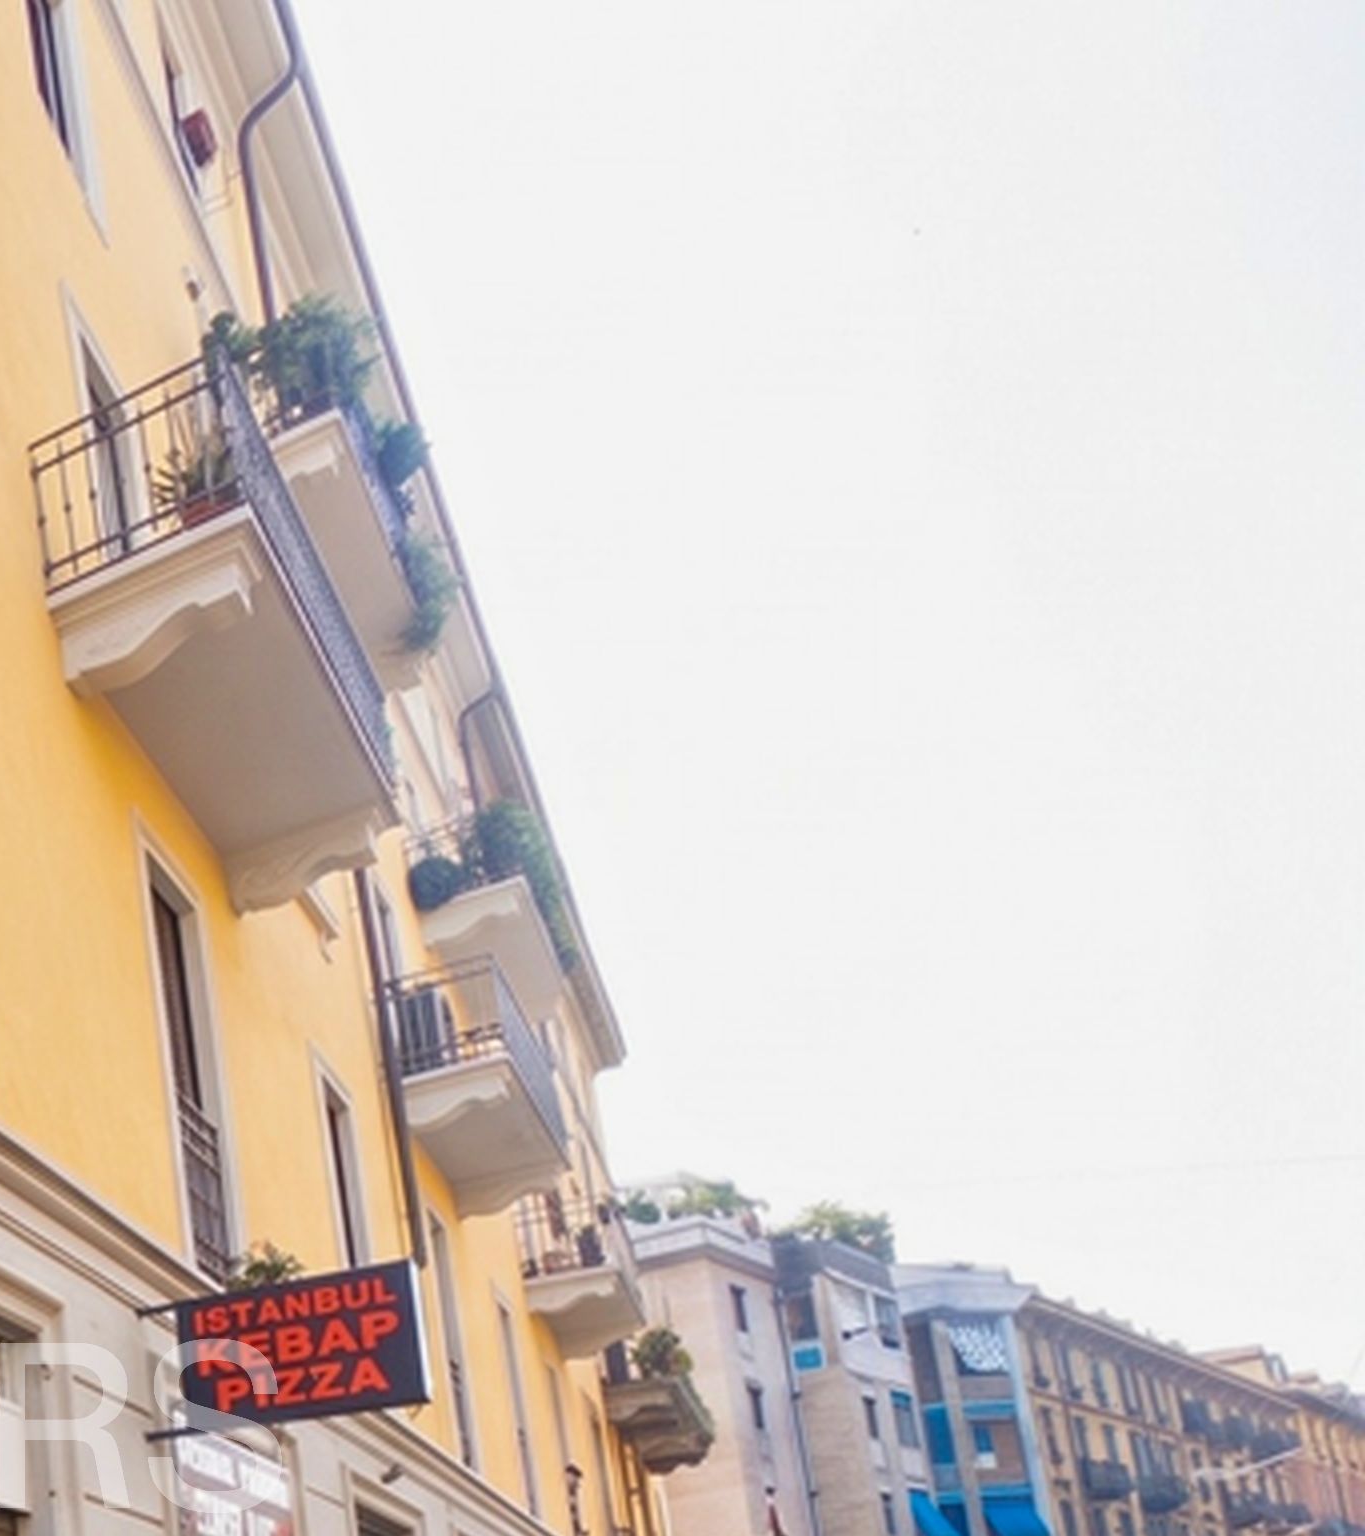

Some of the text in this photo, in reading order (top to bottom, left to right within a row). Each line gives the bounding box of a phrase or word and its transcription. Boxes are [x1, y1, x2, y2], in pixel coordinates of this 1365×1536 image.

[194, 1277, 398, 1336] ISTANBUL
[196, 1310, 400, 1378] KEBAP
[215, 1357, 390, 1413] PIZZA
